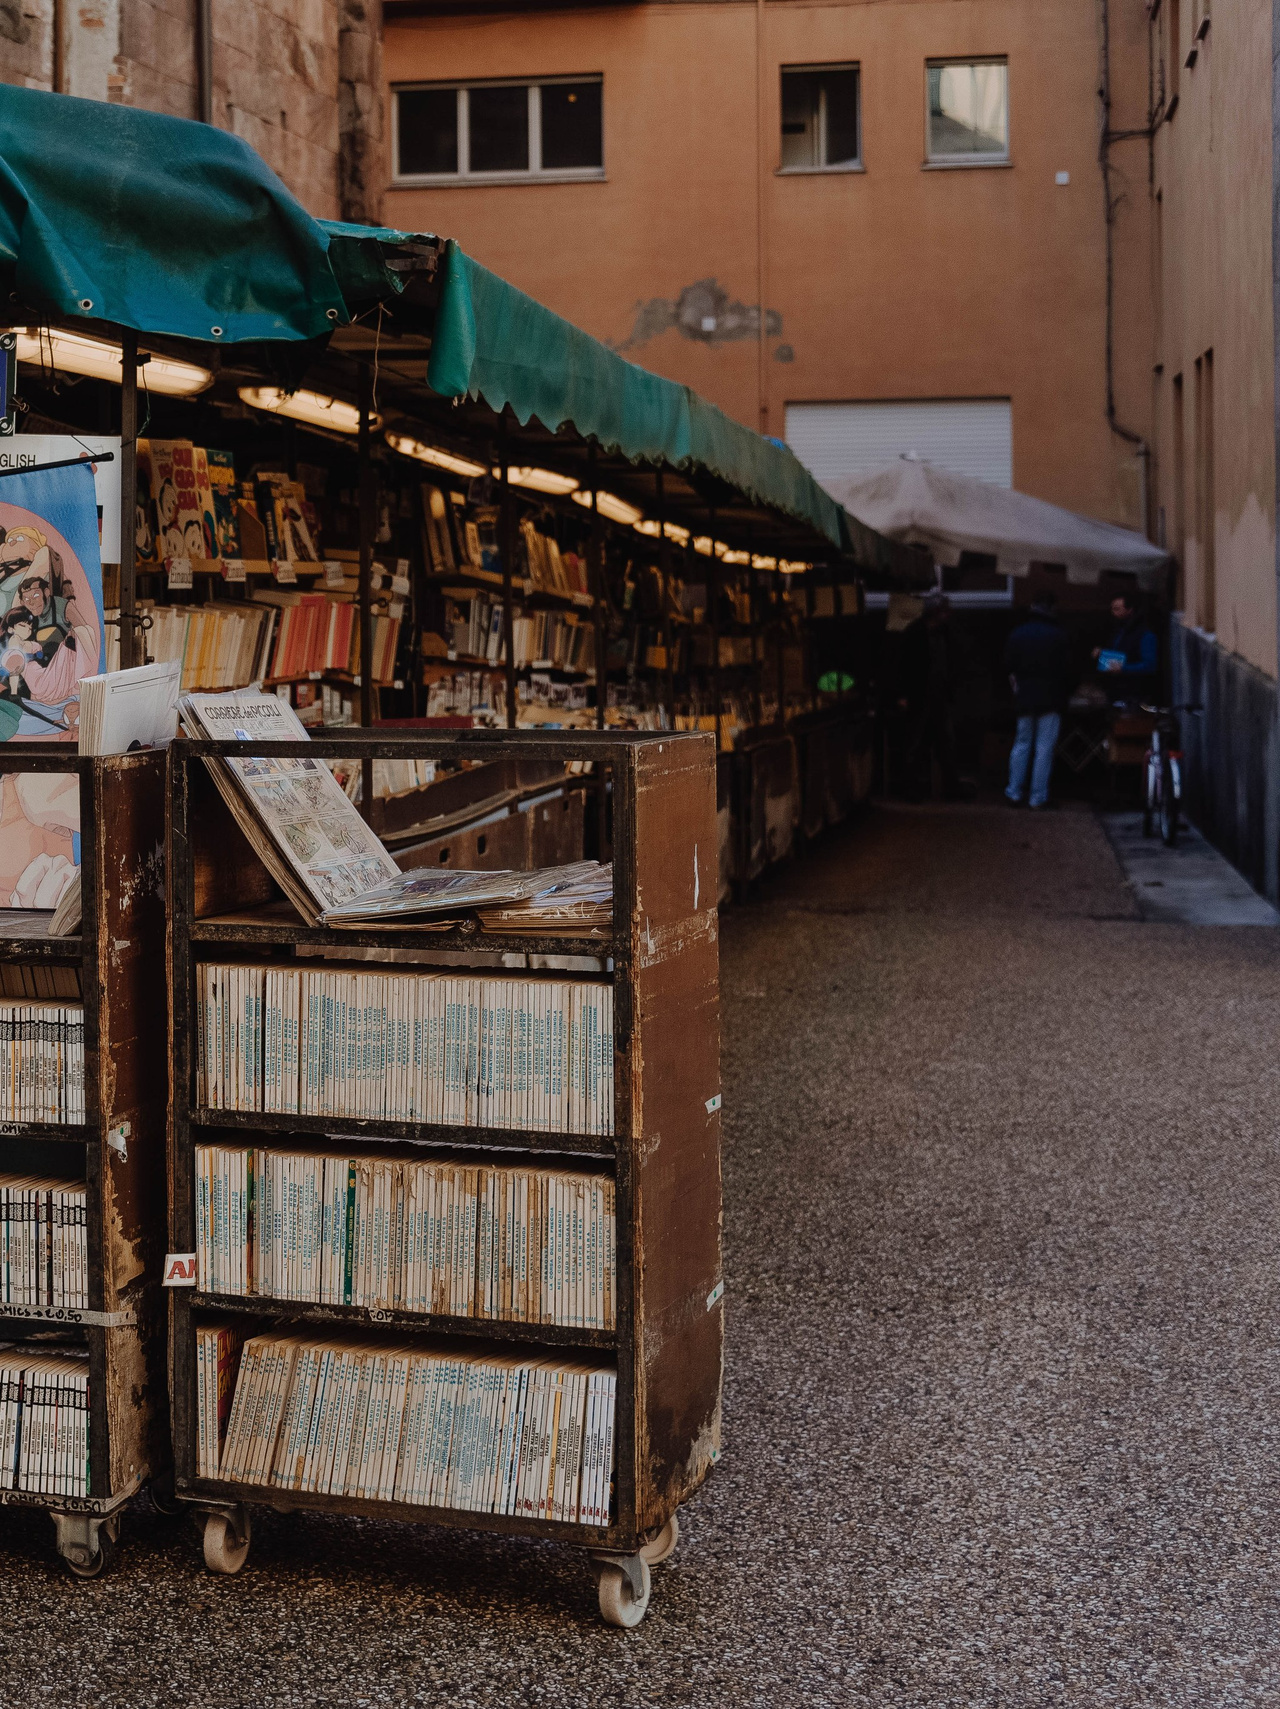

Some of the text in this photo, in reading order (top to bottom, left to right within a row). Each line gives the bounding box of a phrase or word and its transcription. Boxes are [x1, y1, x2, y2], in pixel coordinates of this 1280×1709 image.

[205, 706, 245, 720] CORRIERE
[251, 704, 282, 719] PICCOLI
[45, 1308, 84, 1323] €0,50
